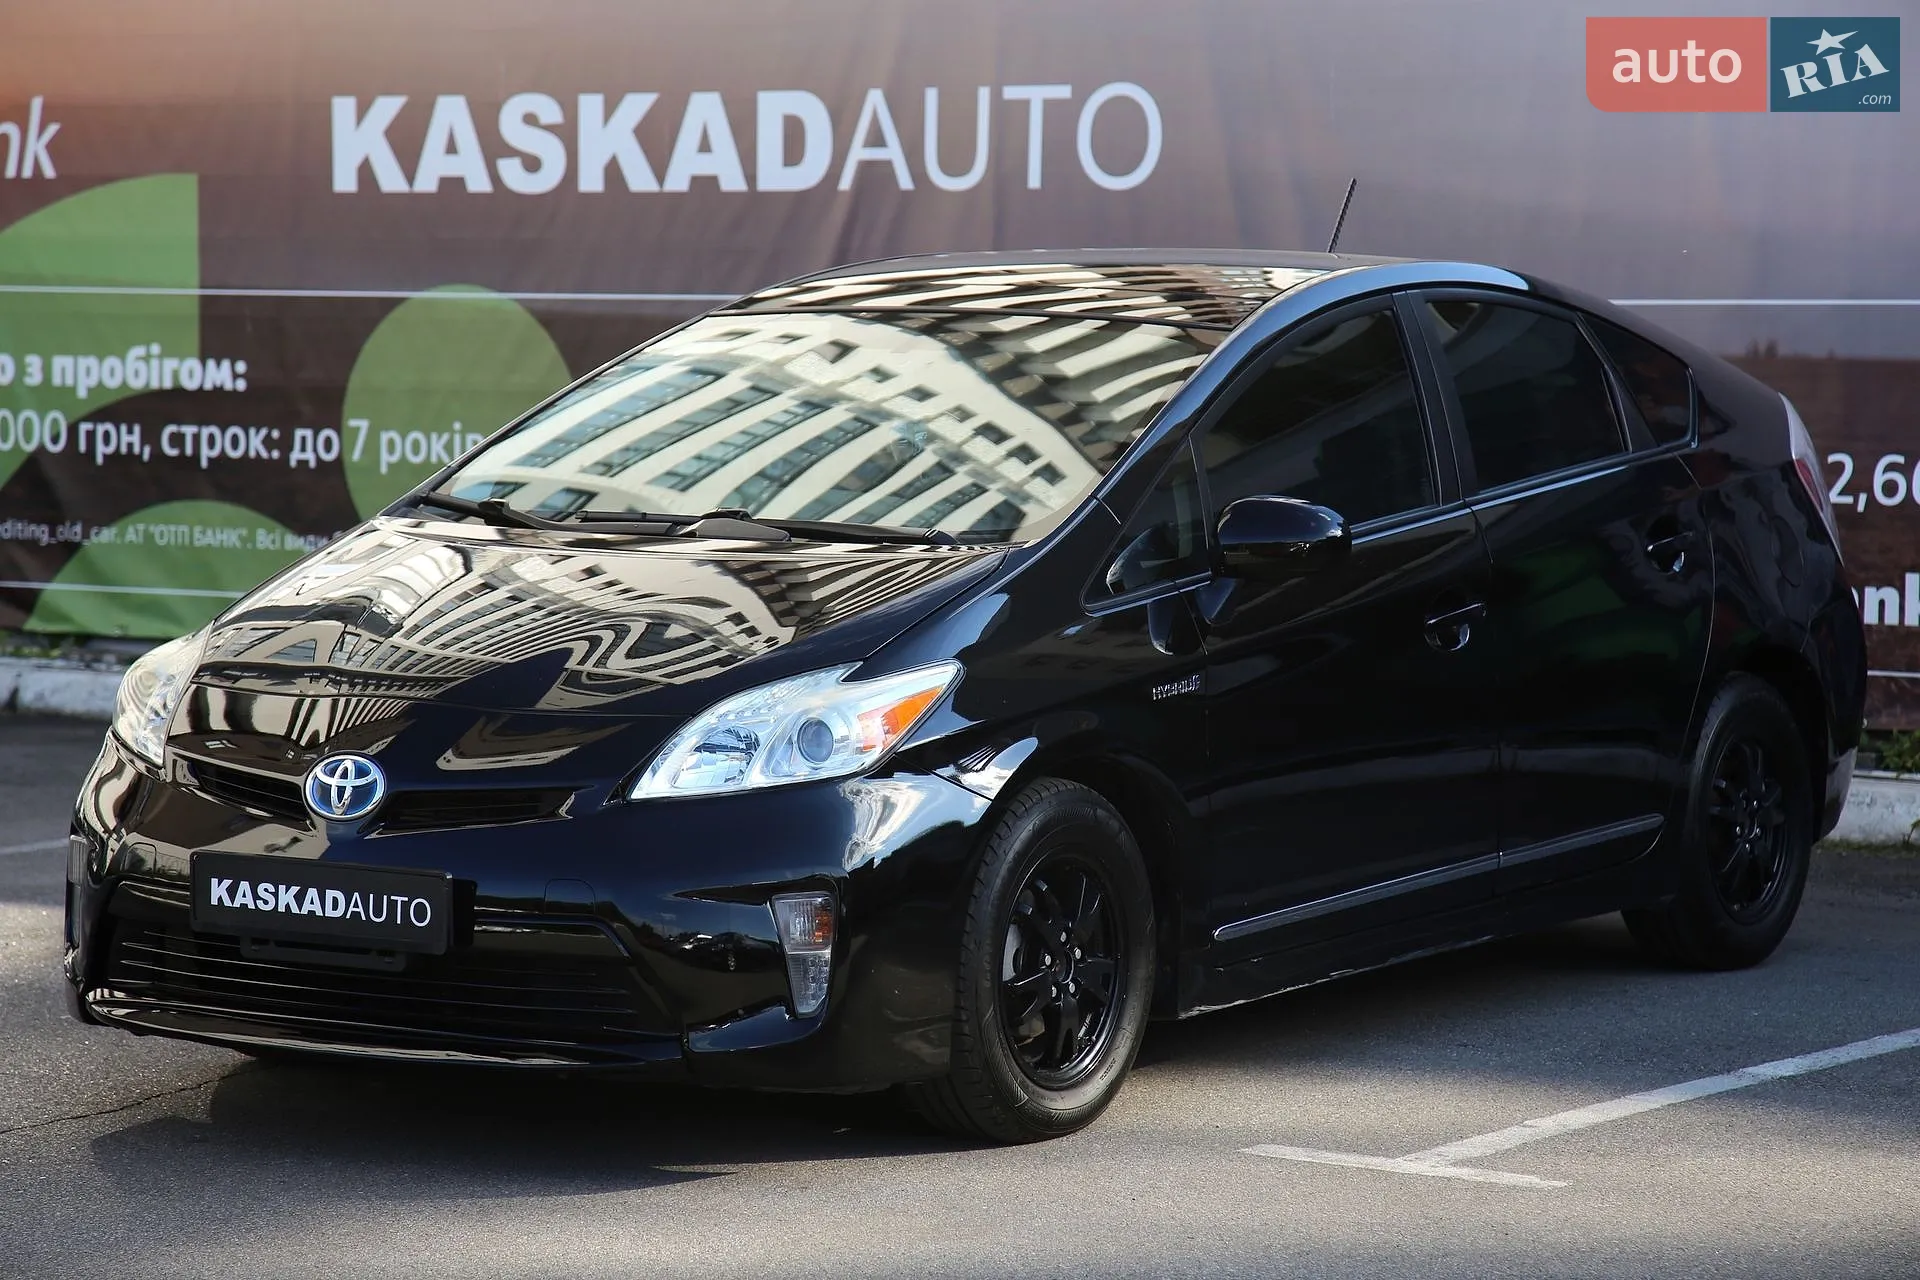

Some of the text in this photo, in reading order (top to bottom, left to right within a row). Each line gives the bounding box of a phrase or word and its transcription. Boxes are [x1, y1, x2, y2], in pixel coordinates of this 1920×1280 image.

[331, 82, 1163, 195] KASKADAUTO
[23, 353, 44, 387] з
[51, 343, 248, 399] пробігом:
[78, 422, 151, 465] грн,
[160, 424, 280, 469] строк:
[289, 428, 340, 468] до
[347, 418, 370, 462] 7
[1827, 453, 1920, 513] 2,6
[210, 877, 432, 927] KASKADAUTO
